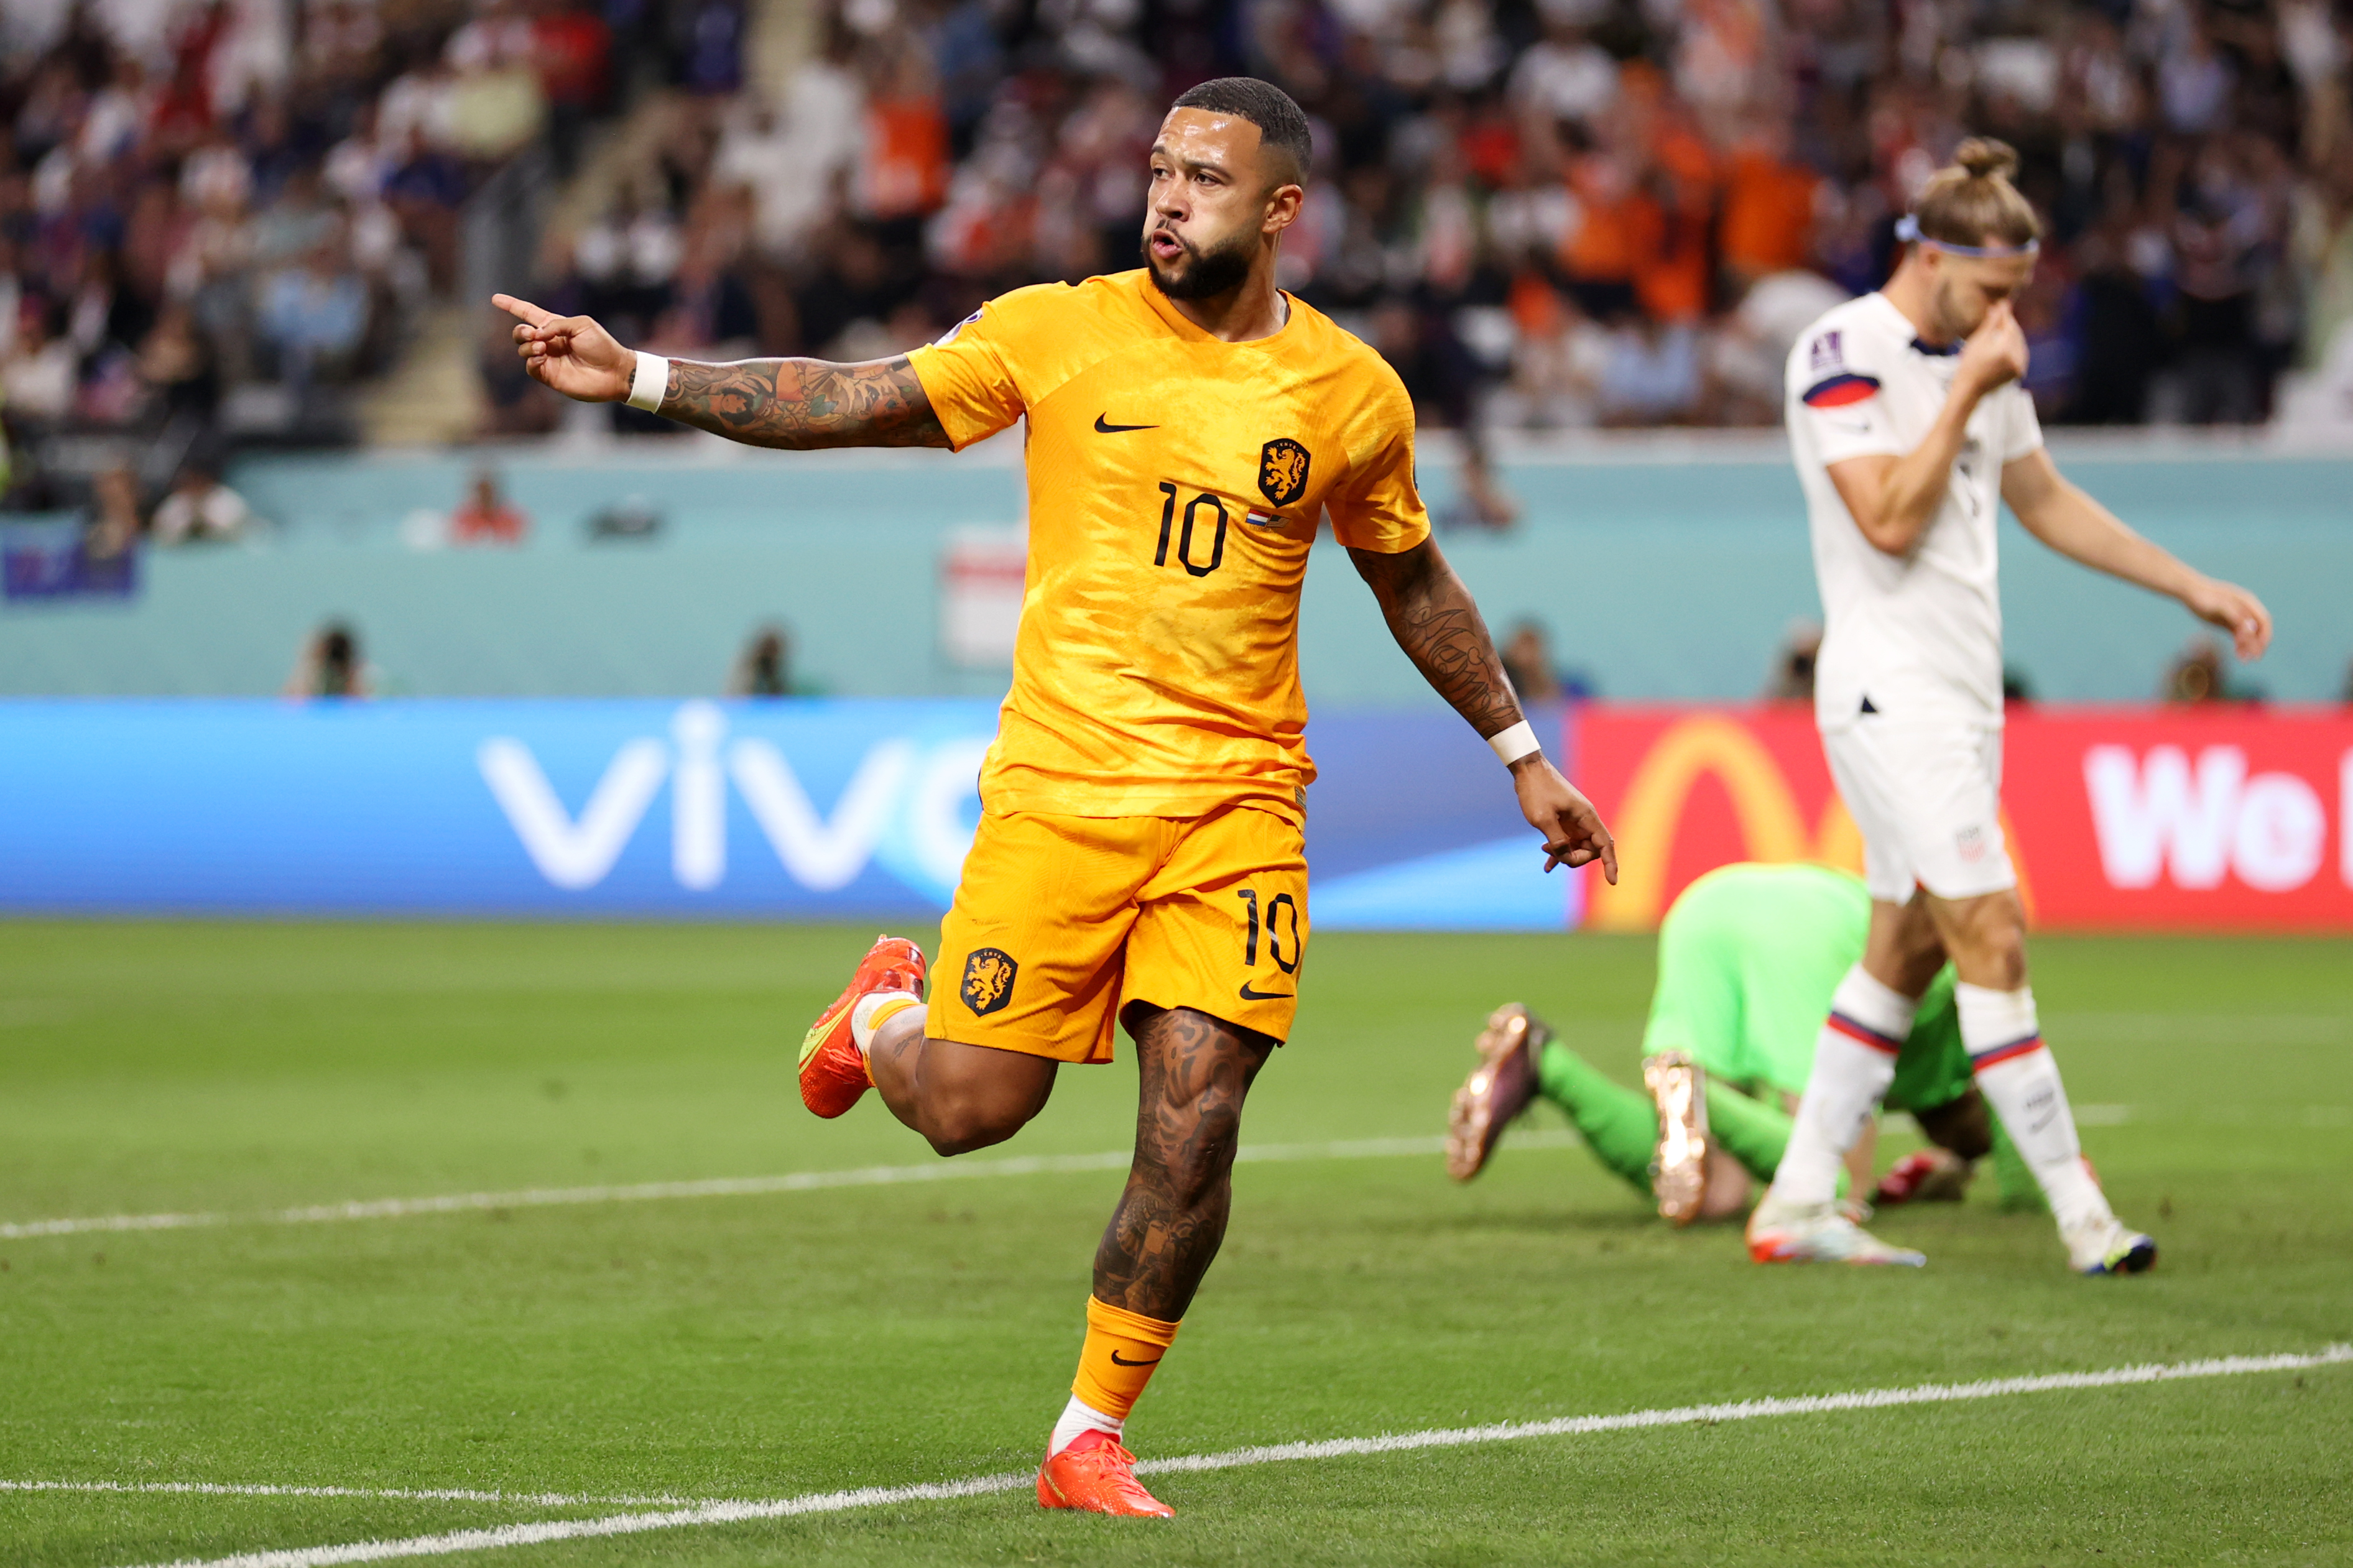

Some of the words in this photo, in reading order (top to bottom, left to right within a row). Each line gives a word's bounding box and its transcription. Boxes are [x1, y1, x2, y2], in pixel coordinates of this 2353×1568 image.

[1154, 481, 1228, 577] 10
[2081, 744, 2327, 893] We
[1237, 889, 1300, 974] 10
